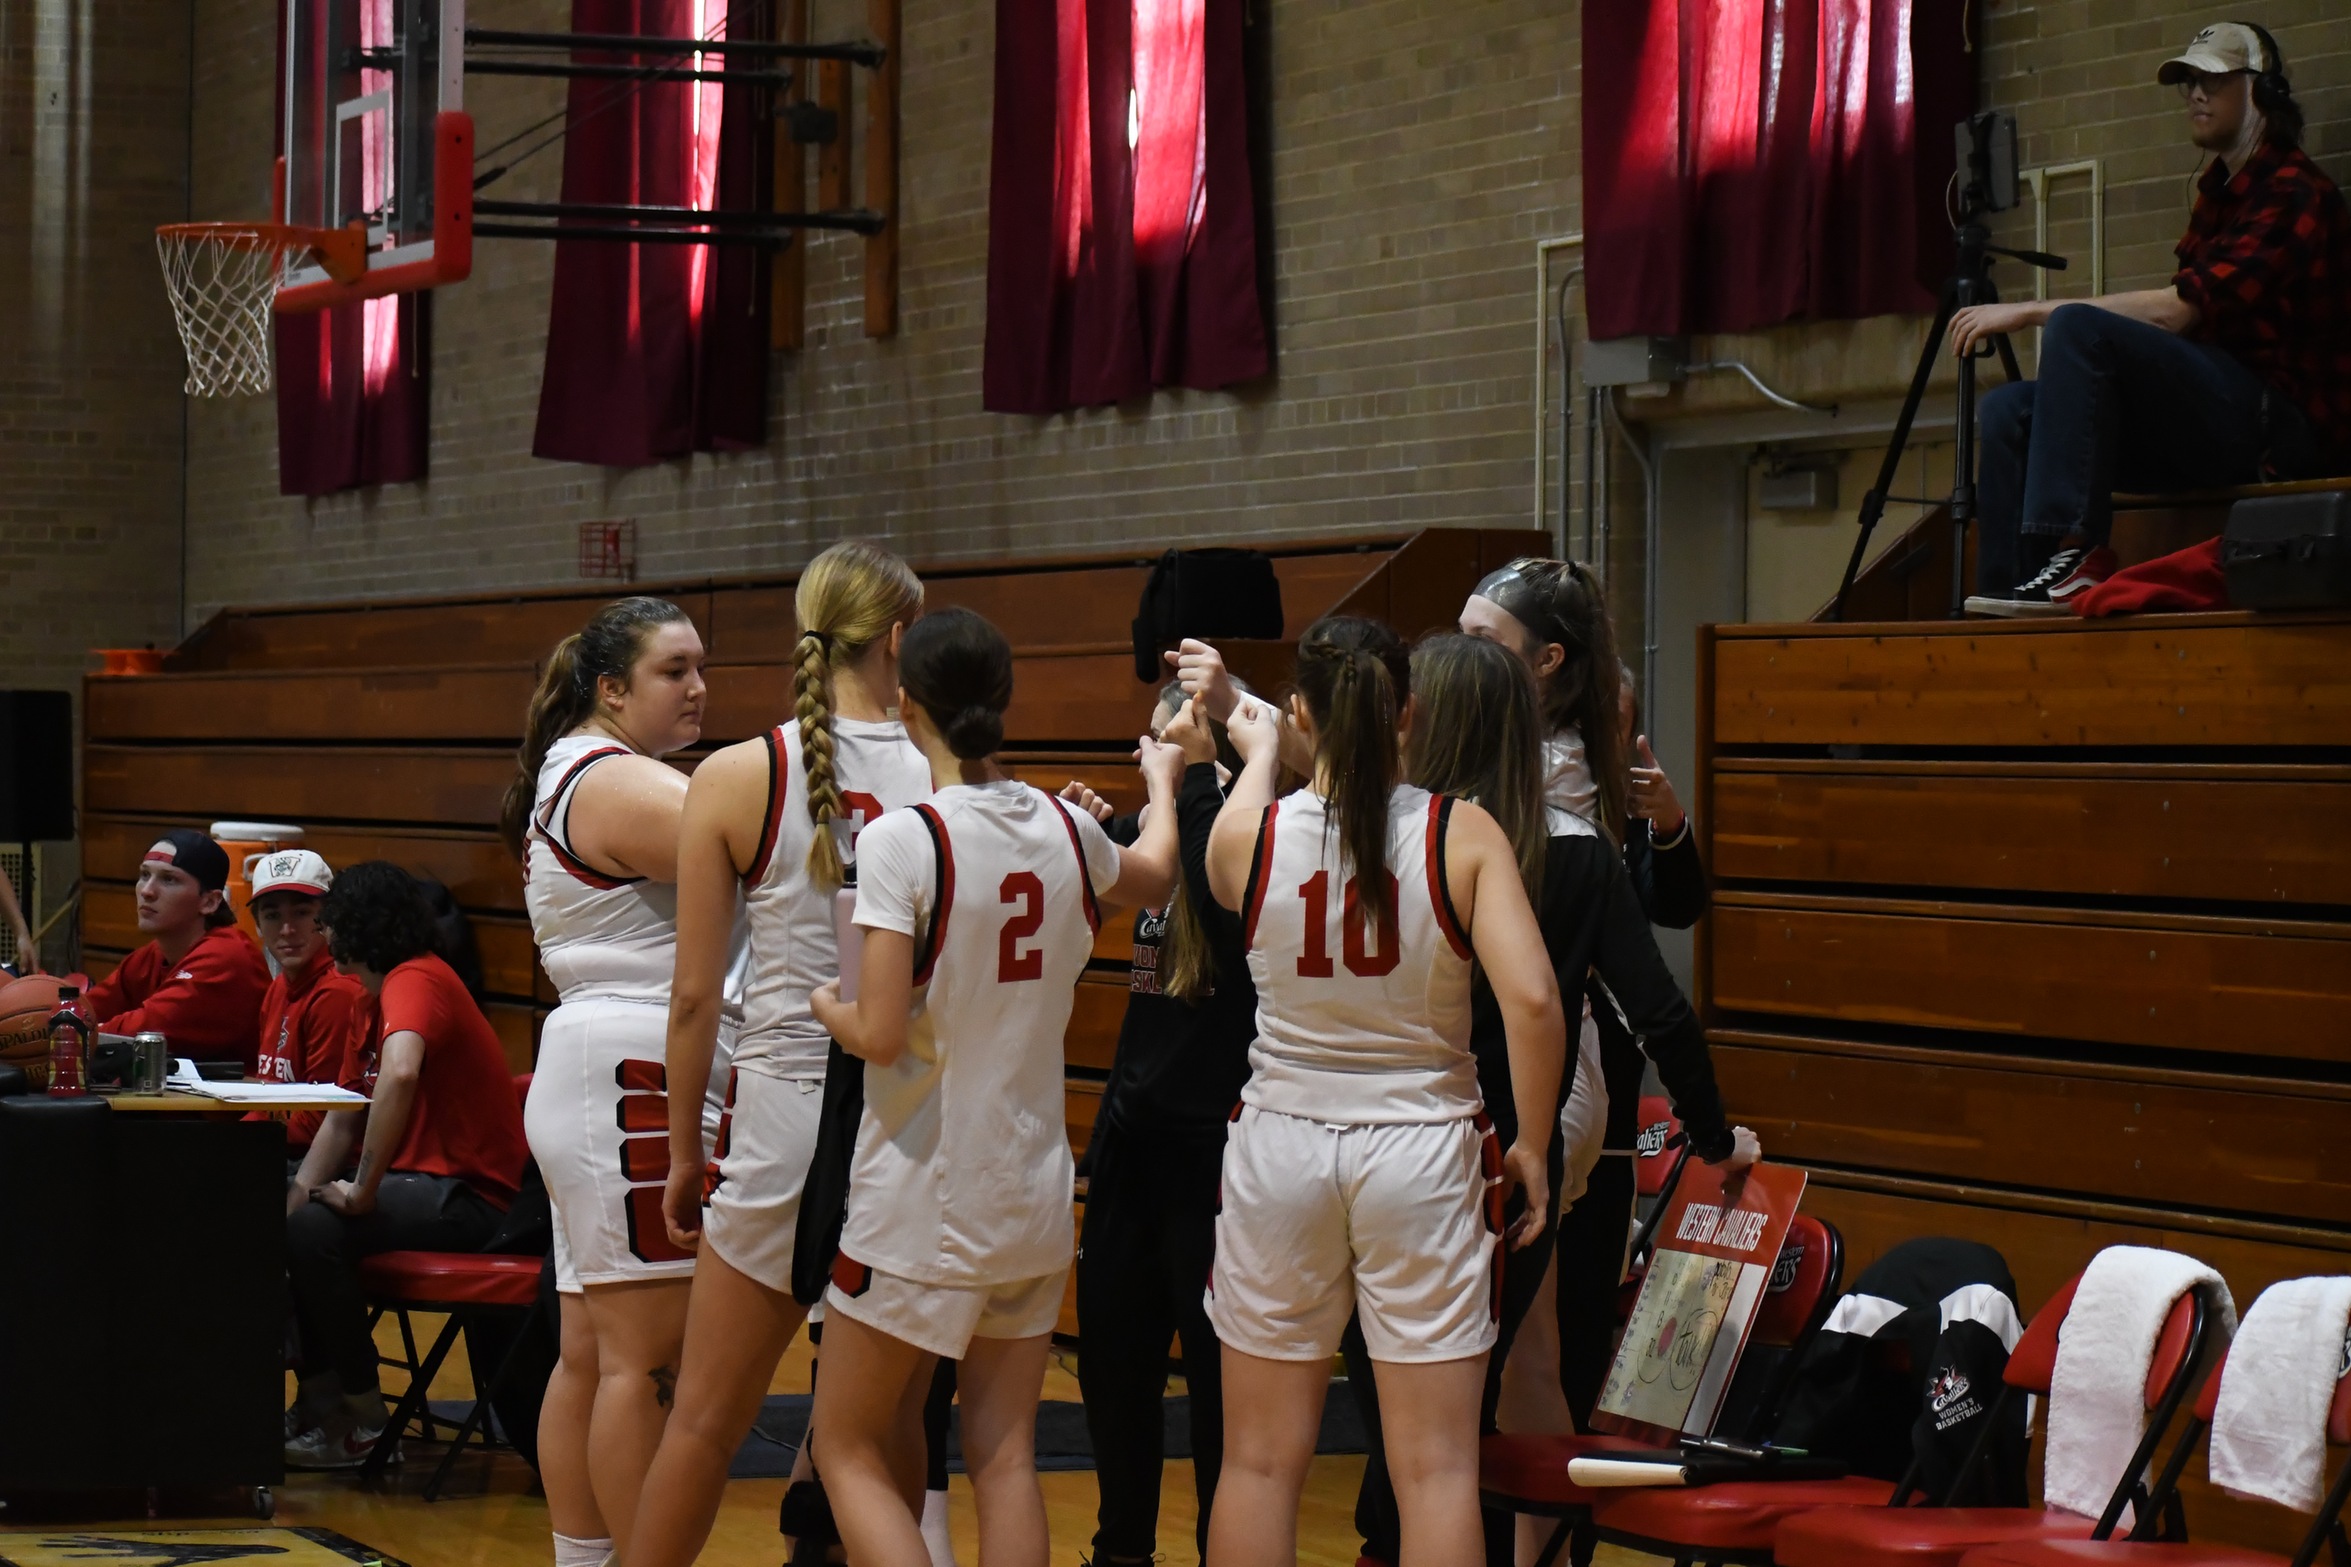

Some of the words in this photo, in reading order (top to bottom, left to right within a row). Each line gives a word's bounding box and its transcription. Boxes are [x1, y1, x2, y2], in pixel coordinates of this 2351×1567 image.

[998, 871, 1044, 983] 2
[1140, 917, 1167, 938] Caval
[1297, 867, 1400, 978] 10
[1676, 1202, 1722, 1243] WESTERN
[1713, 1208, 1768, 1252] CAVALIERS
[1935, 1403, 1983, 1430] BASKETBALL
[1938, 1397, 1975, 1419] WOMEN'S
